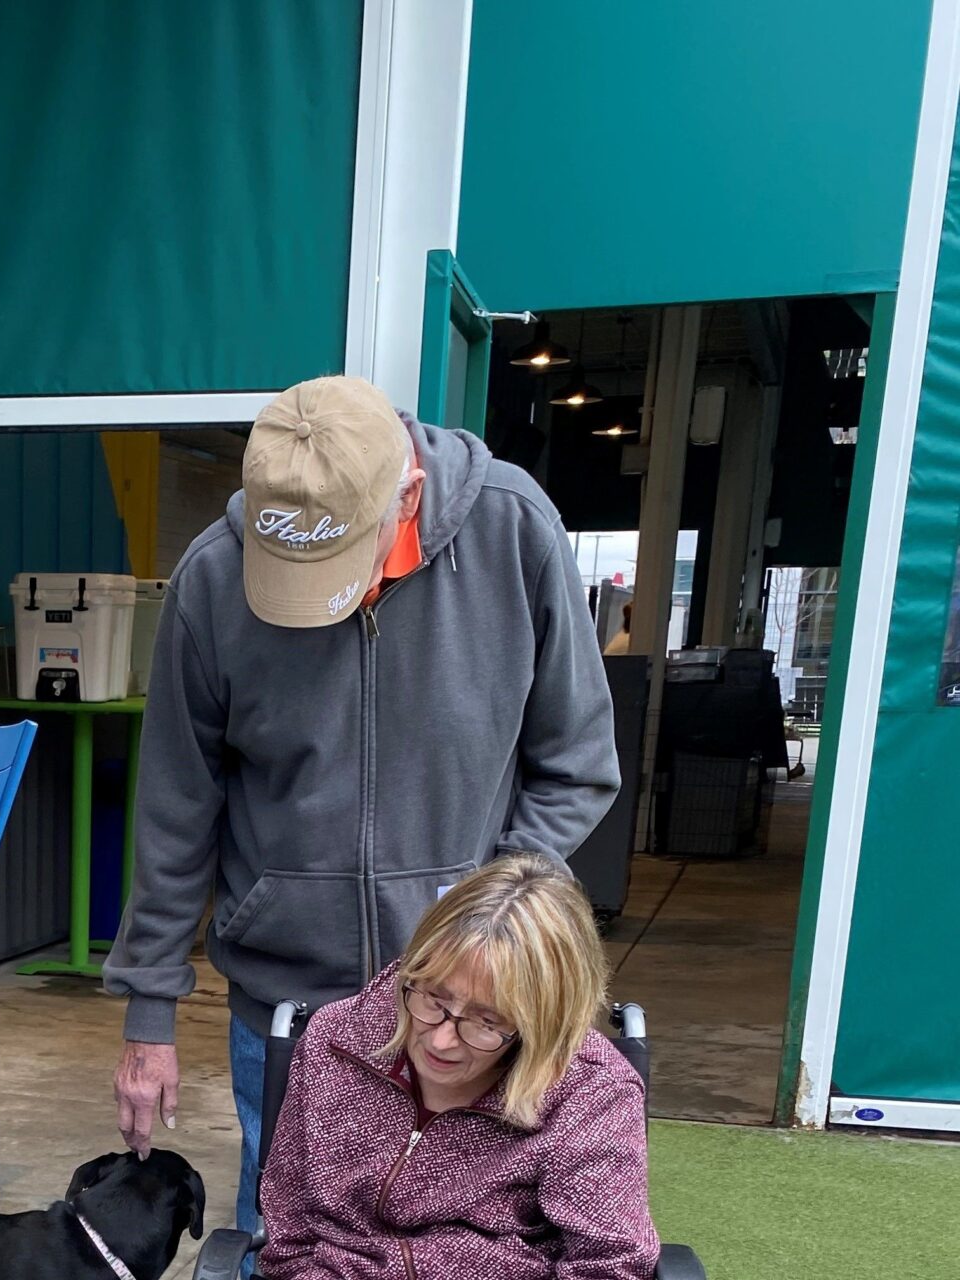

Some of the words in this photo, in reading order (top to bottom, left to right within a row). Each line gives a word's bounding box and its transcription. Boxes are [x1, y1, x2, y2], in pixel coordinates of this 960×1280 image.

[255, 508, 350, 543] Italia
[328, 580, 360, 615] Italia
[47, 612, 70, 621] YETI
